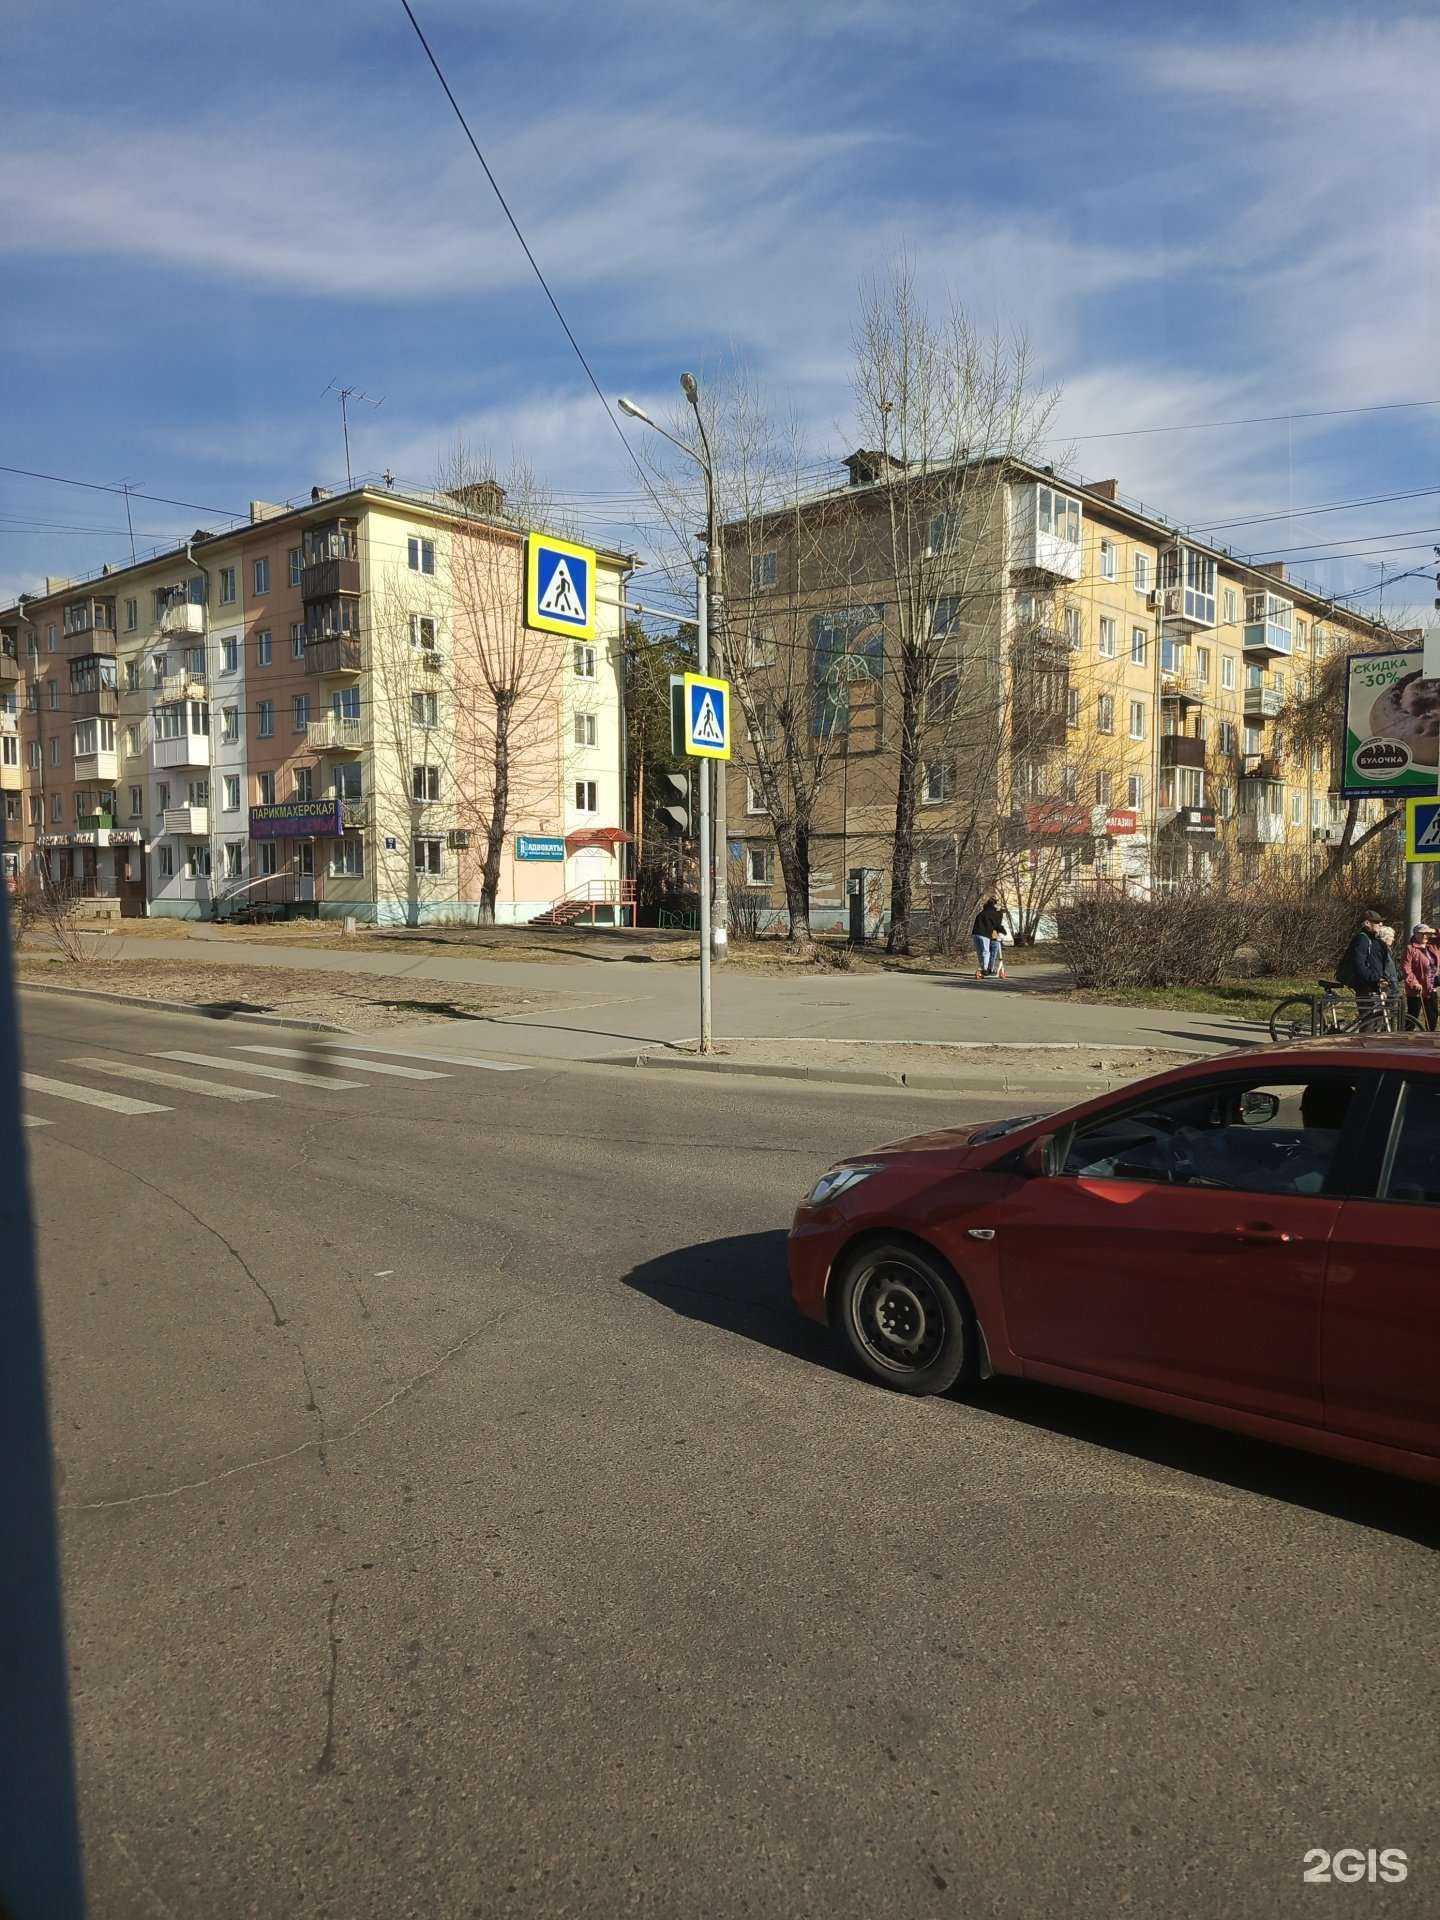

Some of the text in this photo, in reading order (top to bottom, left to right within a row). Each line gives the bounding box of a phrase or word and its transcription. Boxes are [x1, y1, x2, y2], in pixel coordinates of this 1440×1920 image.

[1354, 659, 1408, 674] СКИДКА
[1360, 672, 1399, 687] -30%
[1360, 756, 1403, 765] БУЛОЧКА
[252, 802, 335, 819] ПАРИКМАХЕРСКАЯ
[528, 843, 563, 851] АДВОКАТЫ
